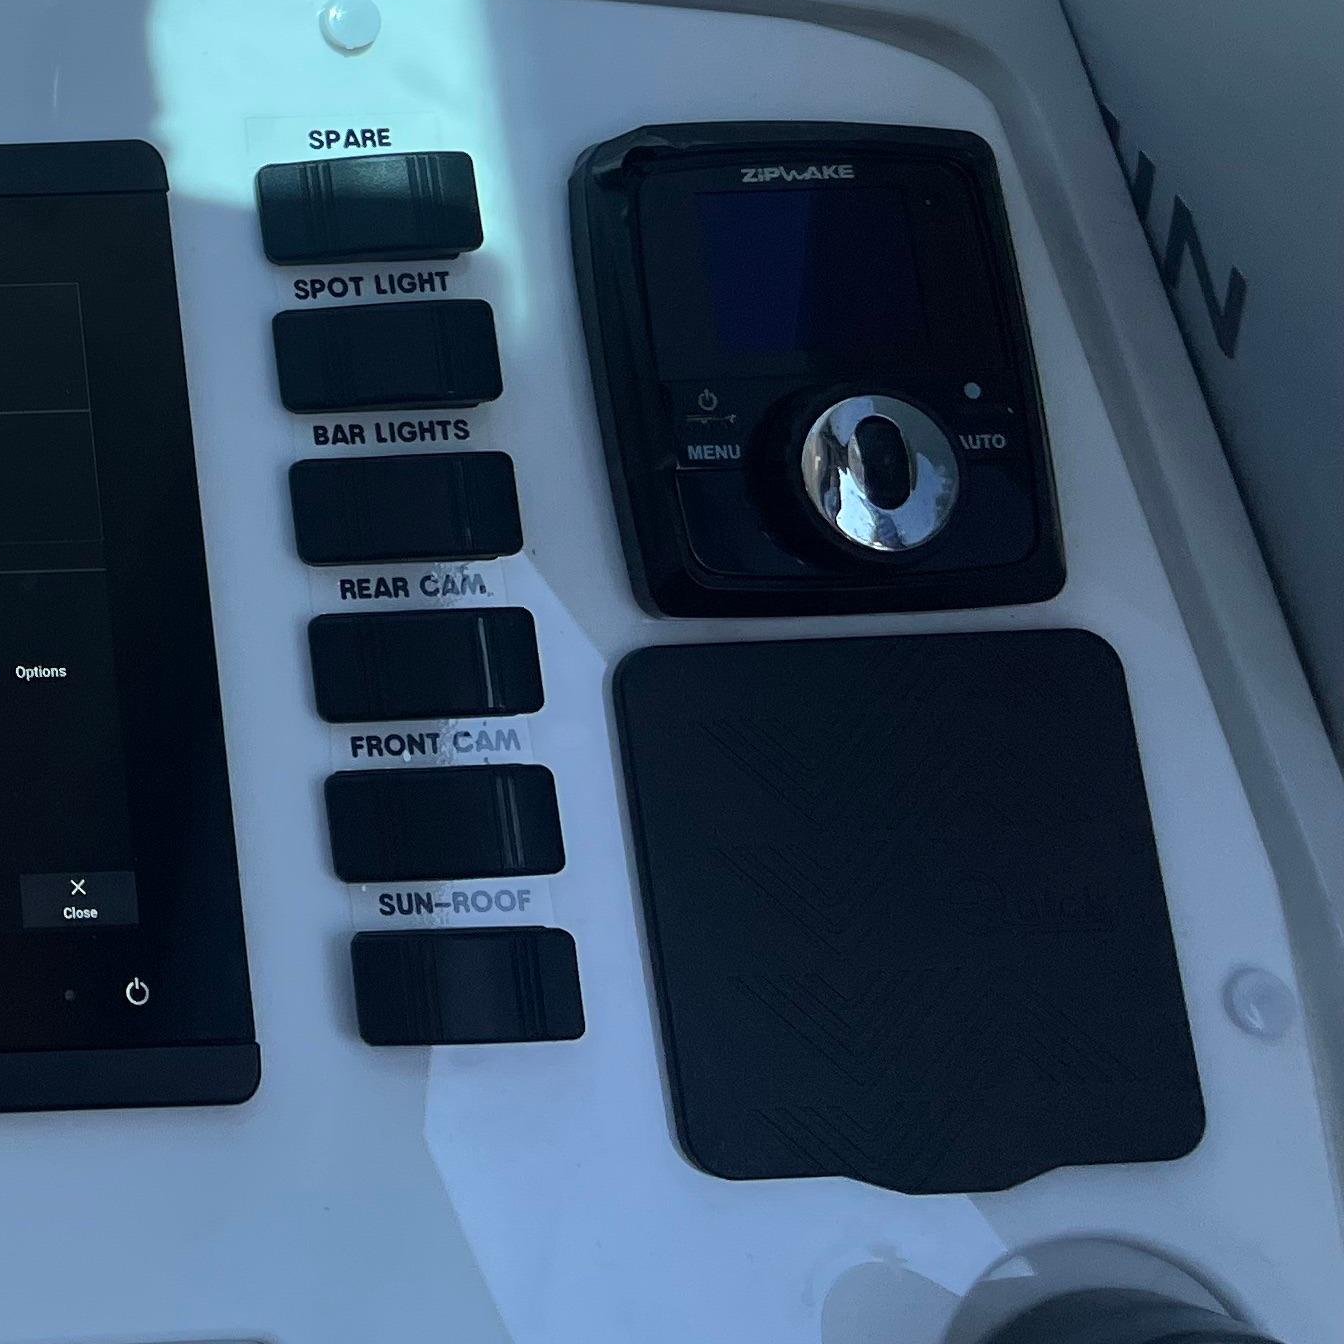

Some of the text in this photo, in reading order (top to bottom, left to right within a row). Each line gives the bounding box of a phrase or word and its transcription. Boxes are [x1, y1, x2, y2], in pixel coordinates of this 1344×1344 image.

[309, 127, 392, 150] SPARE
[740, 165, 856, 183] ZIPWAKE
[294, 271, 450, 300] SPOT LIGHT
[313, 419, 471, 446] BAR LIGHTS
[687, 444, 741, 460] MENU
[339, 577, 410, 600] REAR
[15, 665, 67, 682] Options
[350, 728, 521, 758] FRONT CAM
[63, 906, 98, 920] Close
[379, 889, 531, 916] SUN-ROOF
